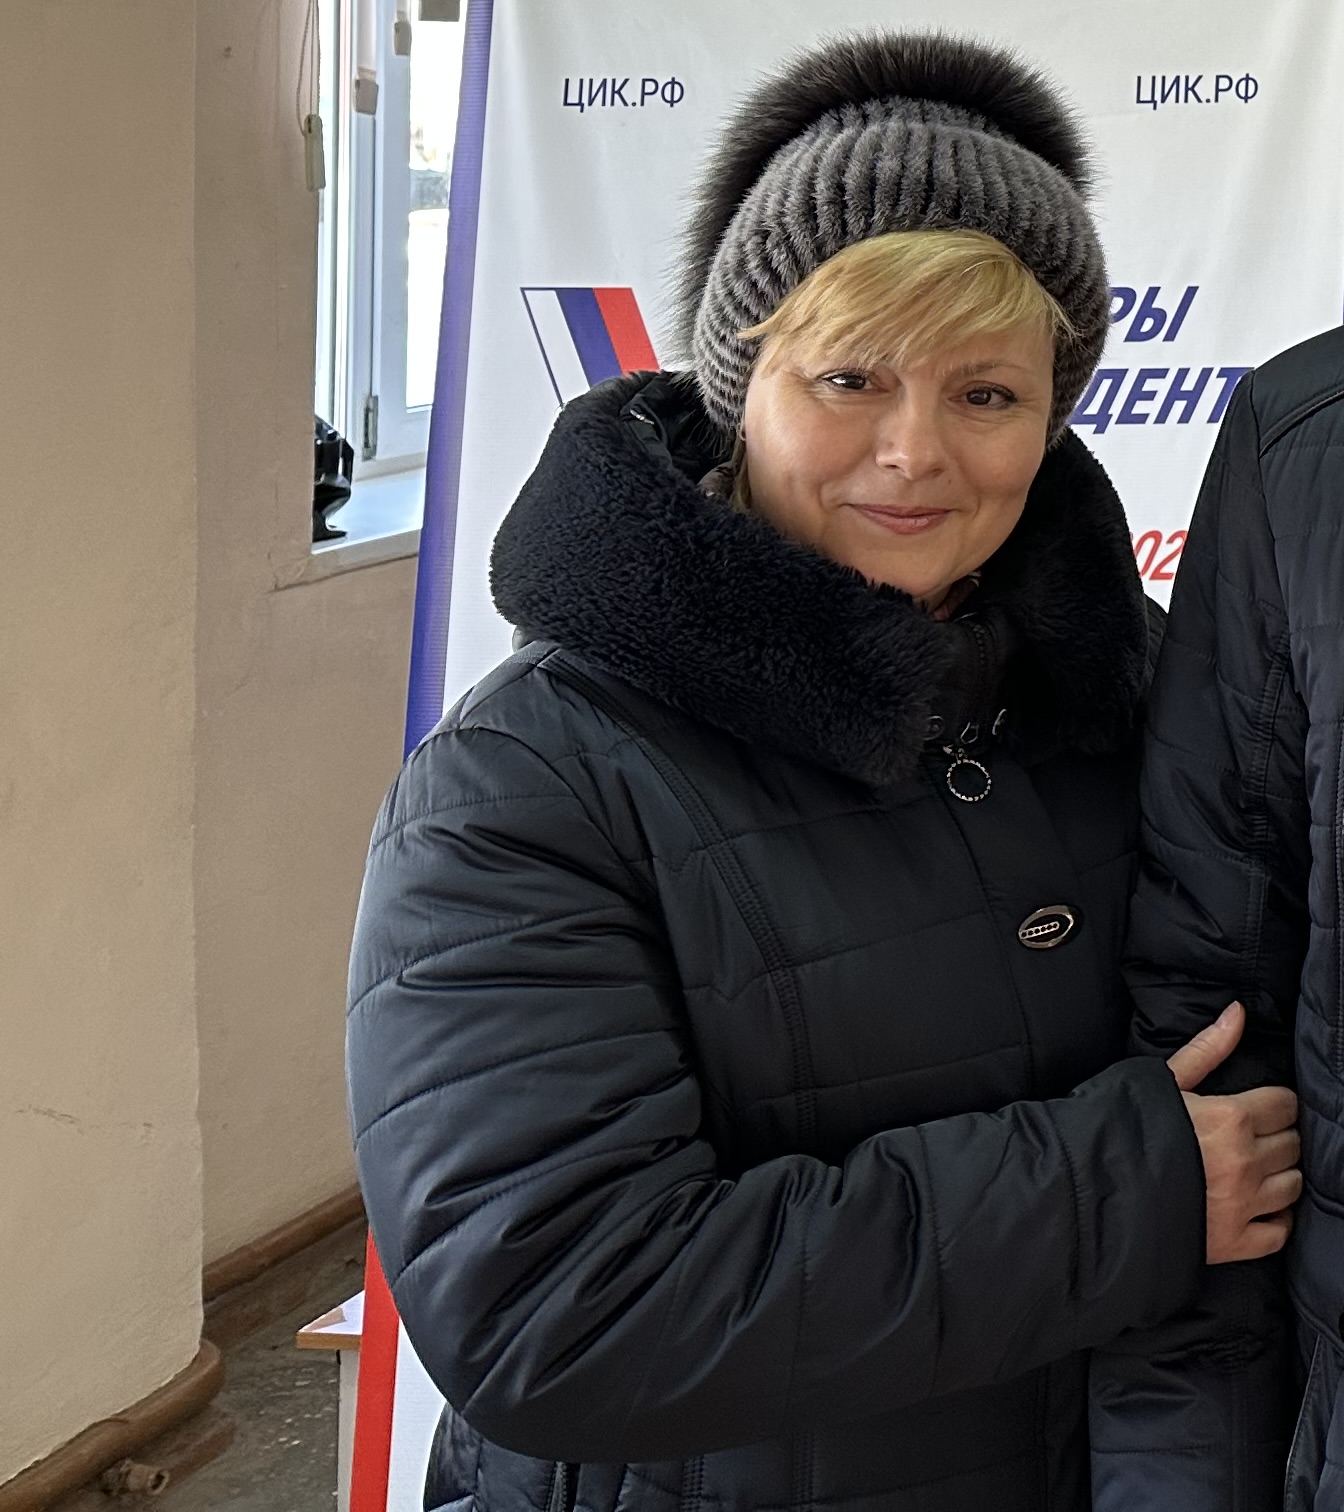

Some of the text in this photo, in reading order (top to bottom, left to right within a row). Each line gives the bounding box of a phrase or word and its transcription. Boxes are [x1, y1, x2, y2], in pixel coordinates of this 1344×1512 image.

[562, 77, 685, 108] ЦИК.РФ
[1135, 73, 1259, 105] ЦИК.РФ
[1109, 286, 1199, 343] РЫ
[1068, 366, 1255, 434] ДЕНТ
